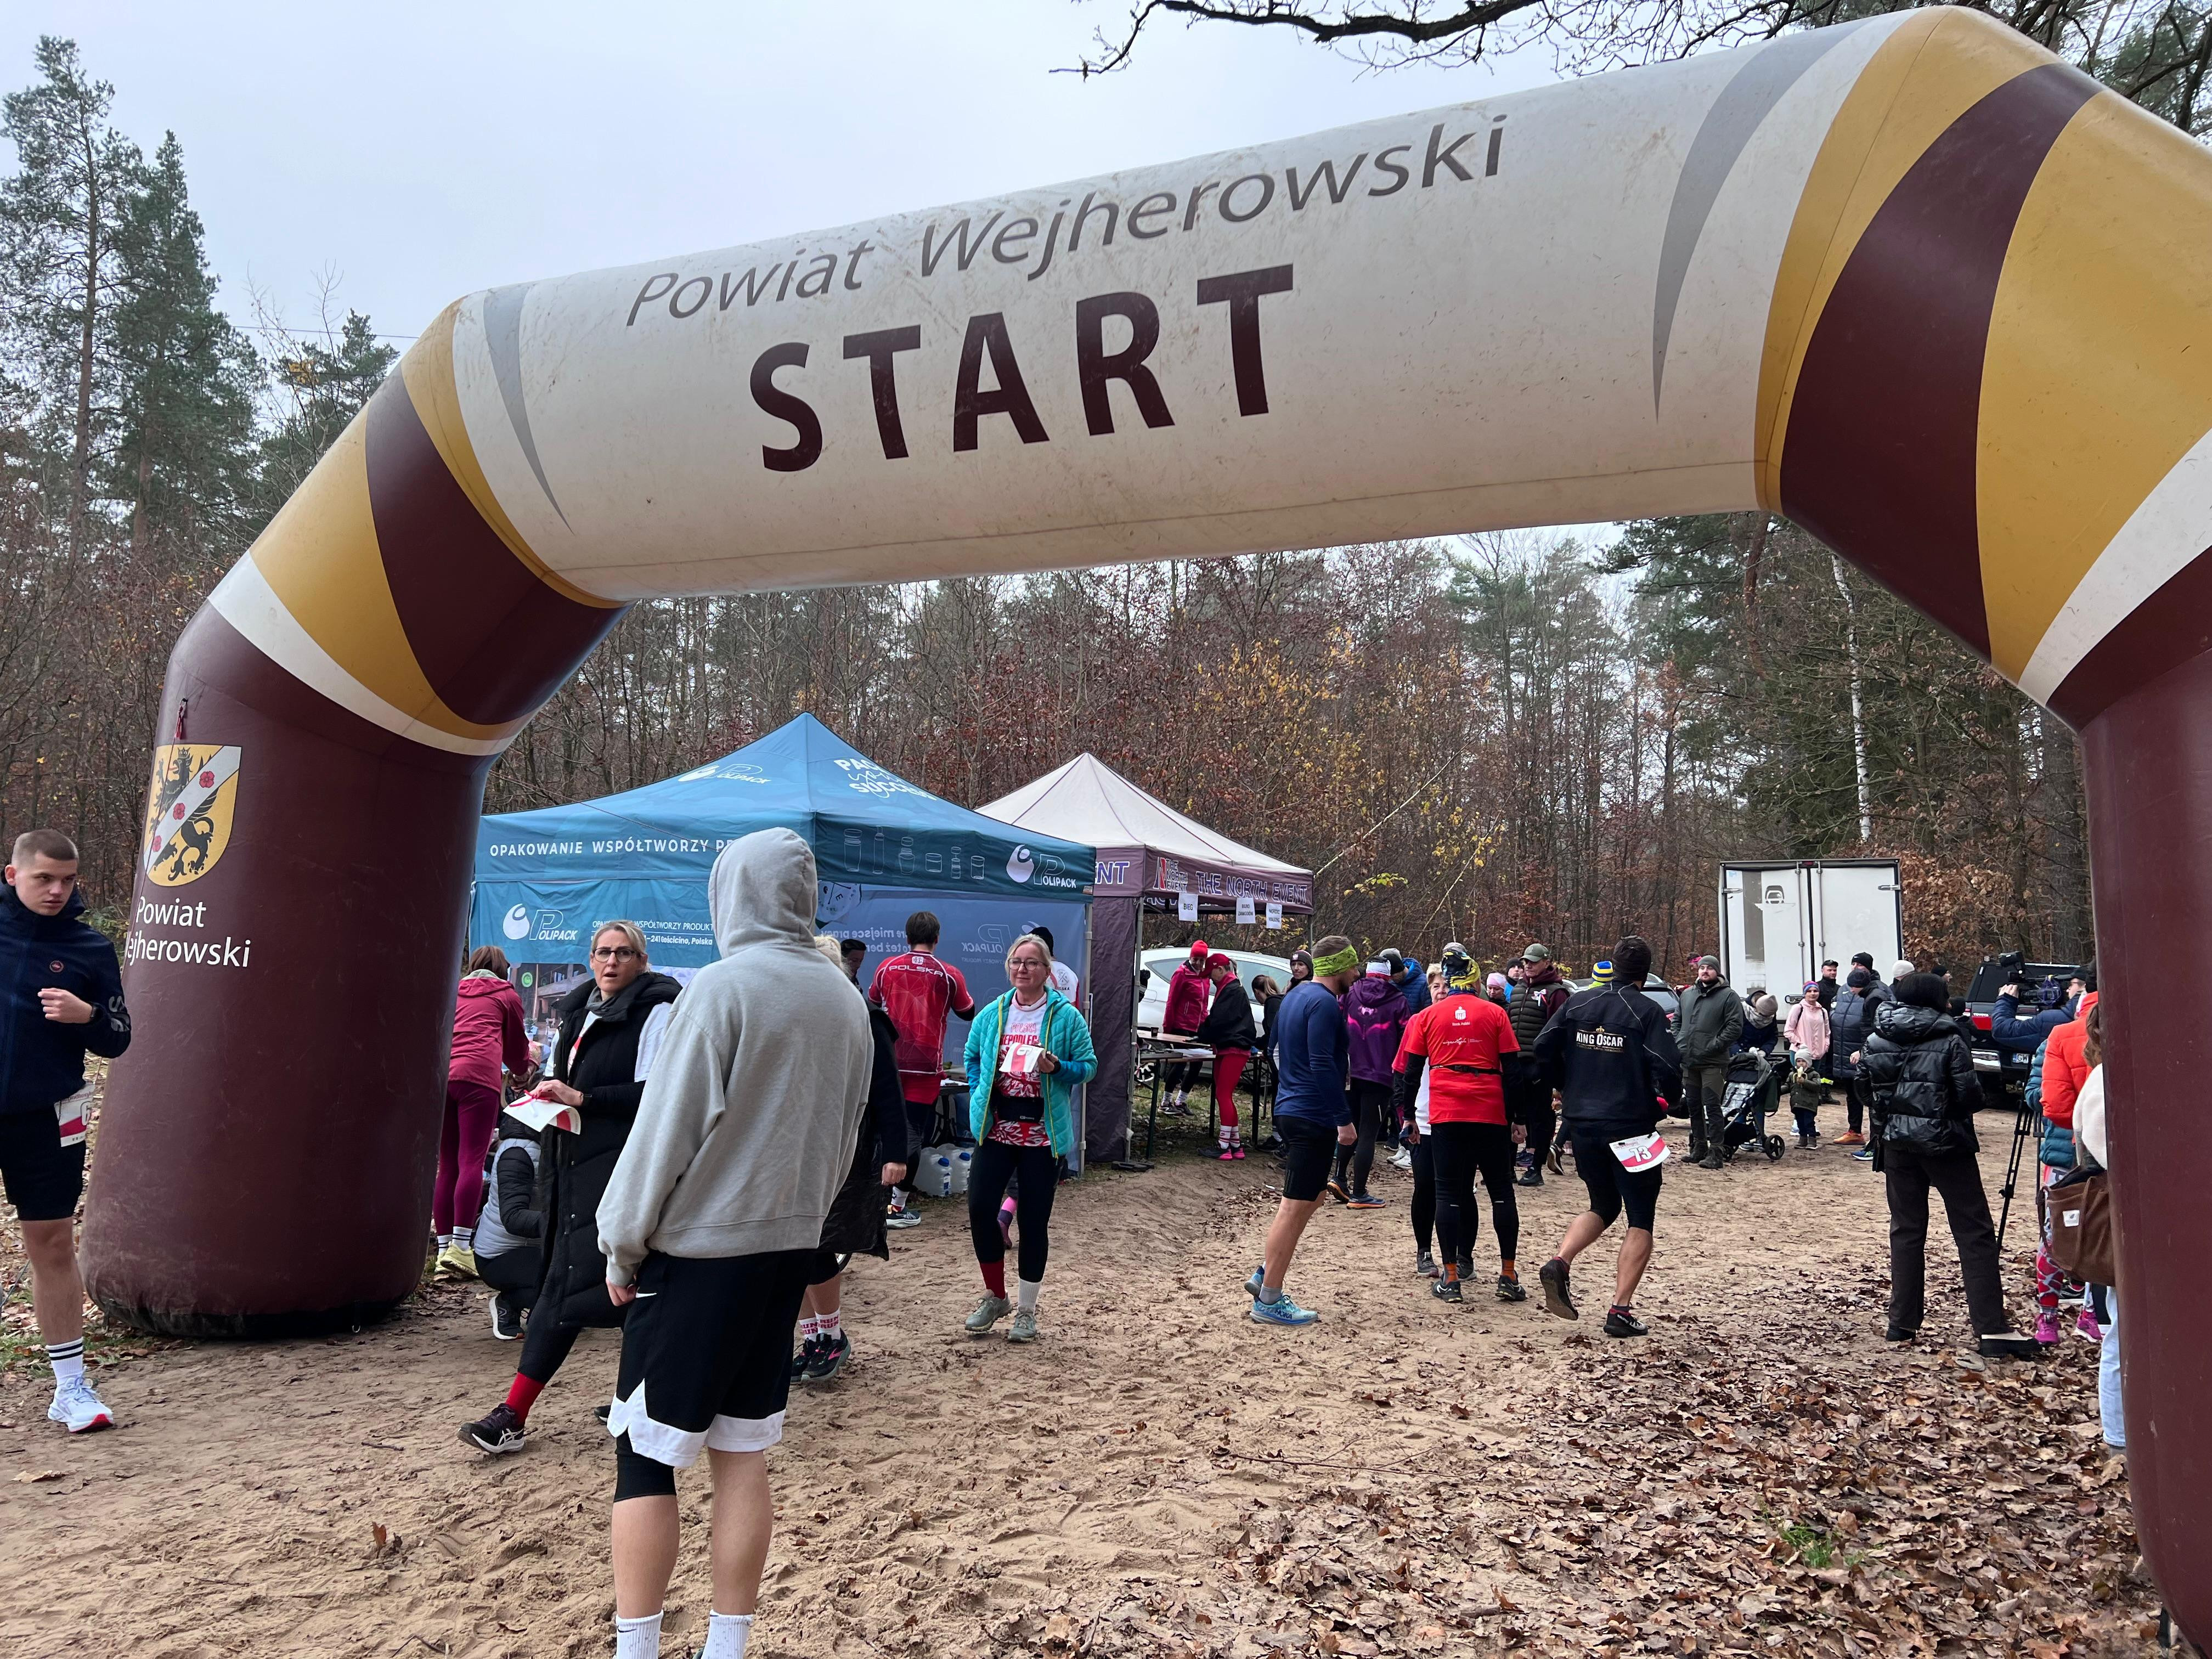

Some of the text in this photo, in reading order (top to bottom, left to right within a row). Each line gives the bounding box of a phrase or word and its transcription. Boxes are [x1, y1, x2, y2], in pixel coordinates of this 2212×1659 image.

[627, 114, 1508, 326] Powiat Wejherowski
[750, 263, 1293, 472] START
[490, 842, 583, 856] OPAKOWANIE
[592, 837, 709, 854] WSPÓŁTWORZY
[1034, 854, 1076, 888] POLIPACK
[1095, 861, 1130, 884] NT
[1166, 859, 1178, 871] THE
[1195, 871, 1307, 904] THE NORTH EVENT
[136, 896, 206, 927] Powiat
[529, 909, 578, 940] POLIPACK
[126, 930, 251, 967] ejherowski
[889, 965, 943, 977] POLSKA
[1011, 1023, 1036, 1032] POLSKA
[1576, 1032, 1594, 1044] KING
[1629, 1146, 1652, 1163] 73
